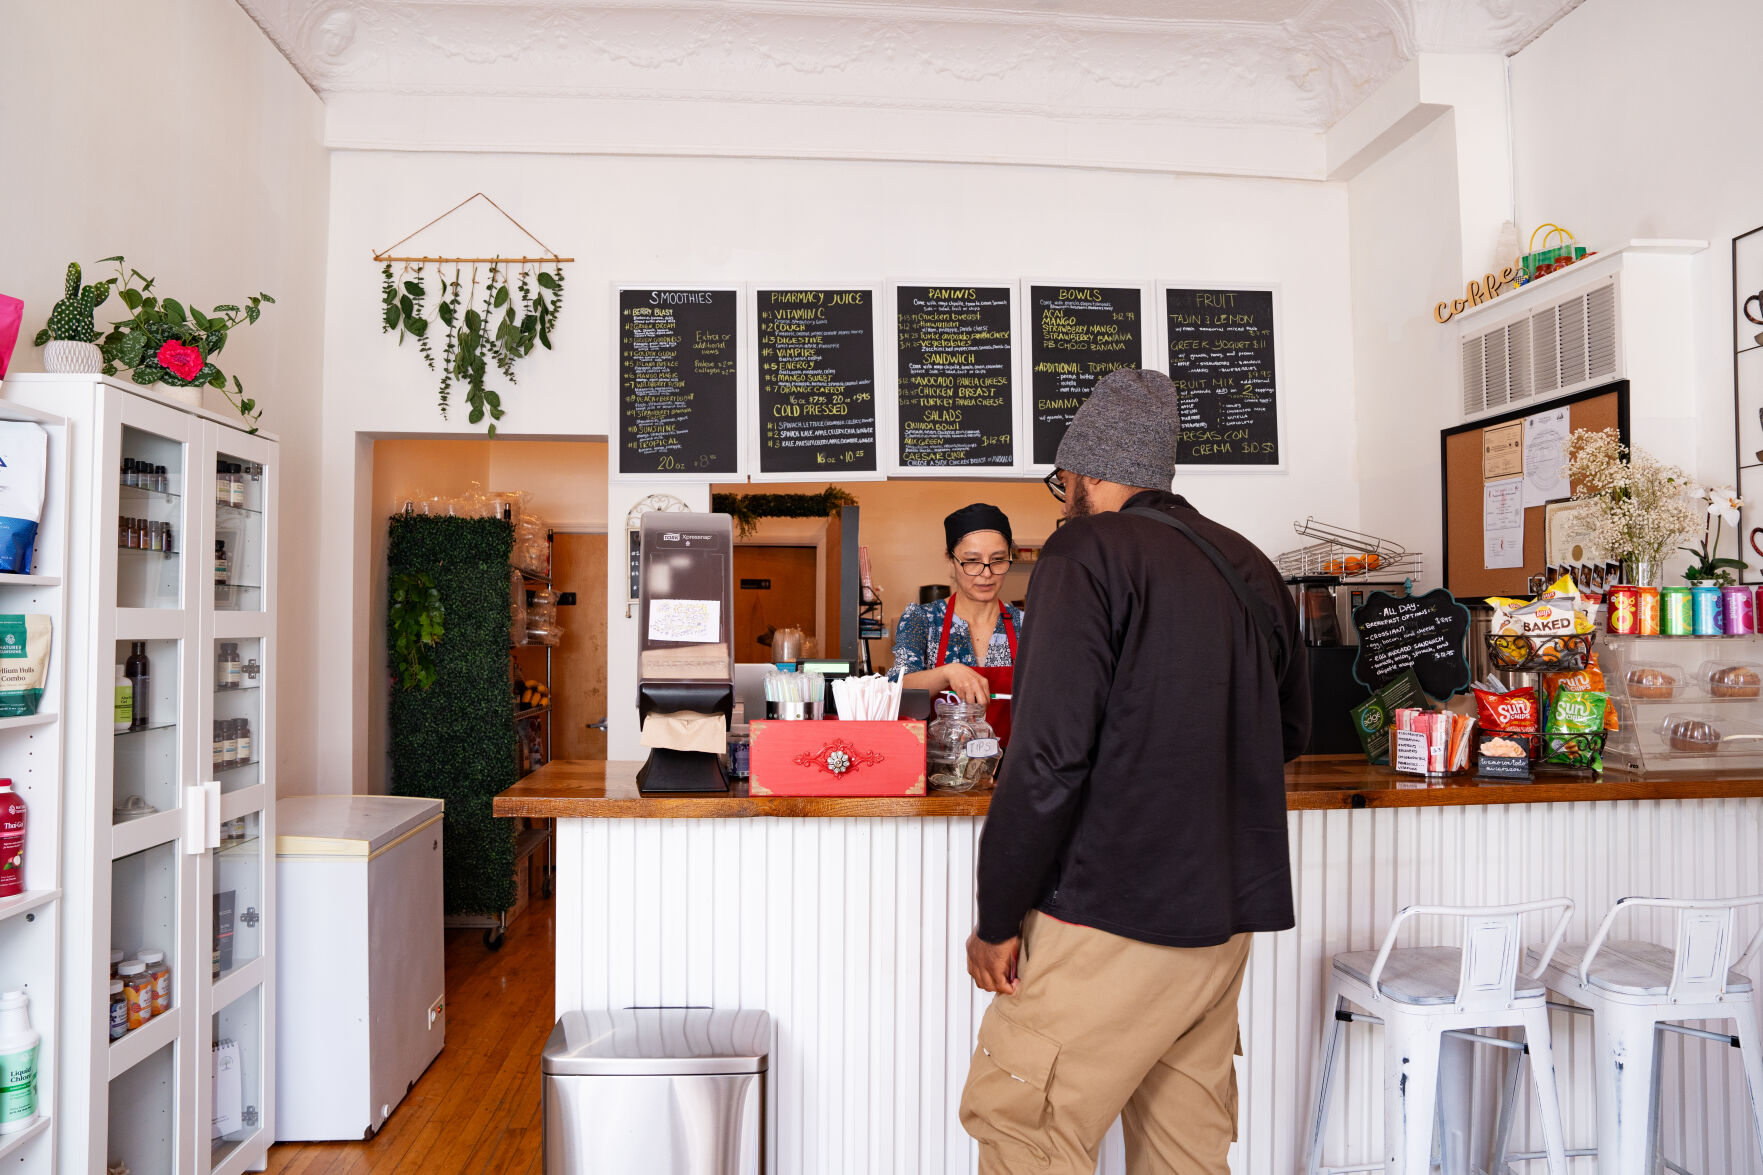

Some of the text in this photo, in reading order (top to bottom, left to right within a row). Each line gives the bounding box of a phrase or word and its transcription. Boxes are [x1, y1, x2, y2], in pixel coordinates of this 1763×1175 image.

[650, 292, 712, 304] SMOOTHIES
[772, 292, 863, 306] PHARMACY JUICE
[928, 289, 976, 299] PANINIS
[1059, 289, 1102, 301] BOWLS
[1196, 293, 1237, 308] FRUIT
[633, 308, 651, 316] BERRY
[655, 308, 673, 316] BLAST
[775, 309, 815, 319] VITAMIN
[818, 308, 825, 318] C
[918, 313, 949, 321] Chicken
[952, 312, 981, 320] breast
[1042, 317, 1076, 325] MANGO
[1170, 314, 1254, 324] TAJIN LEMON
[774, 323, 805, 332] COUGH
[1043, 325, 1117, 333] STRAWBERRY MANGO
[777, 336, 823, 344] DIGESTIVE
[1044, 332, 1133, 343] STRAWBERRY BANANA
[1090, 343, 1126, 351] BANANA
[1170, 340, 1209, 350] GREEK
[1212, 340, 1250, 350] YOGURT
[776, 349, 816, 357] VAMPIRE
[923, 353, 975, 364] SANDWICH
[779, 361, 814, 370] ENERGY
[915, 377, 954, 386] AVOCADO
[981, 377, 1008, 387] CHEESE
[1213, 378, 1234, 386] MIX
[918, 387, 996, 397] CHICKEN BREAST
[1242, 385, 1253, 395] 2
[832, 395, 844, 404] 20
[920, 399, 953, 407] TURKEY
[977, 398, 1004, 406] CHEESE
[1038, 399, 1079, 410] BANANA
[773, 404, 847, 416] COLD PRESSED
[924, 410, 962, 421] SALADS
[639, 425, 676, 434] SUNSHINE
[1224, 429, 1248, 440] CON
[640, 438, 678, 448] TROPICAL
[1192, 443, 1232, 456] CREMA
[902, 453, 943, 461] CAESAR
[658, 456, 674, 470] 20
[1365, 617, 1400, 628] BREAKFAST
[1524, 618, 1570, 632] BAKED
[1414, 636, 1444, 649] SANDWICH
[1498, 703, 1530, 723] Sun
[1556, 701, 1587, 720] Sun
[971, 742, 990, 753] TIPS
[10, 1067, 32, 1077] Liquid
